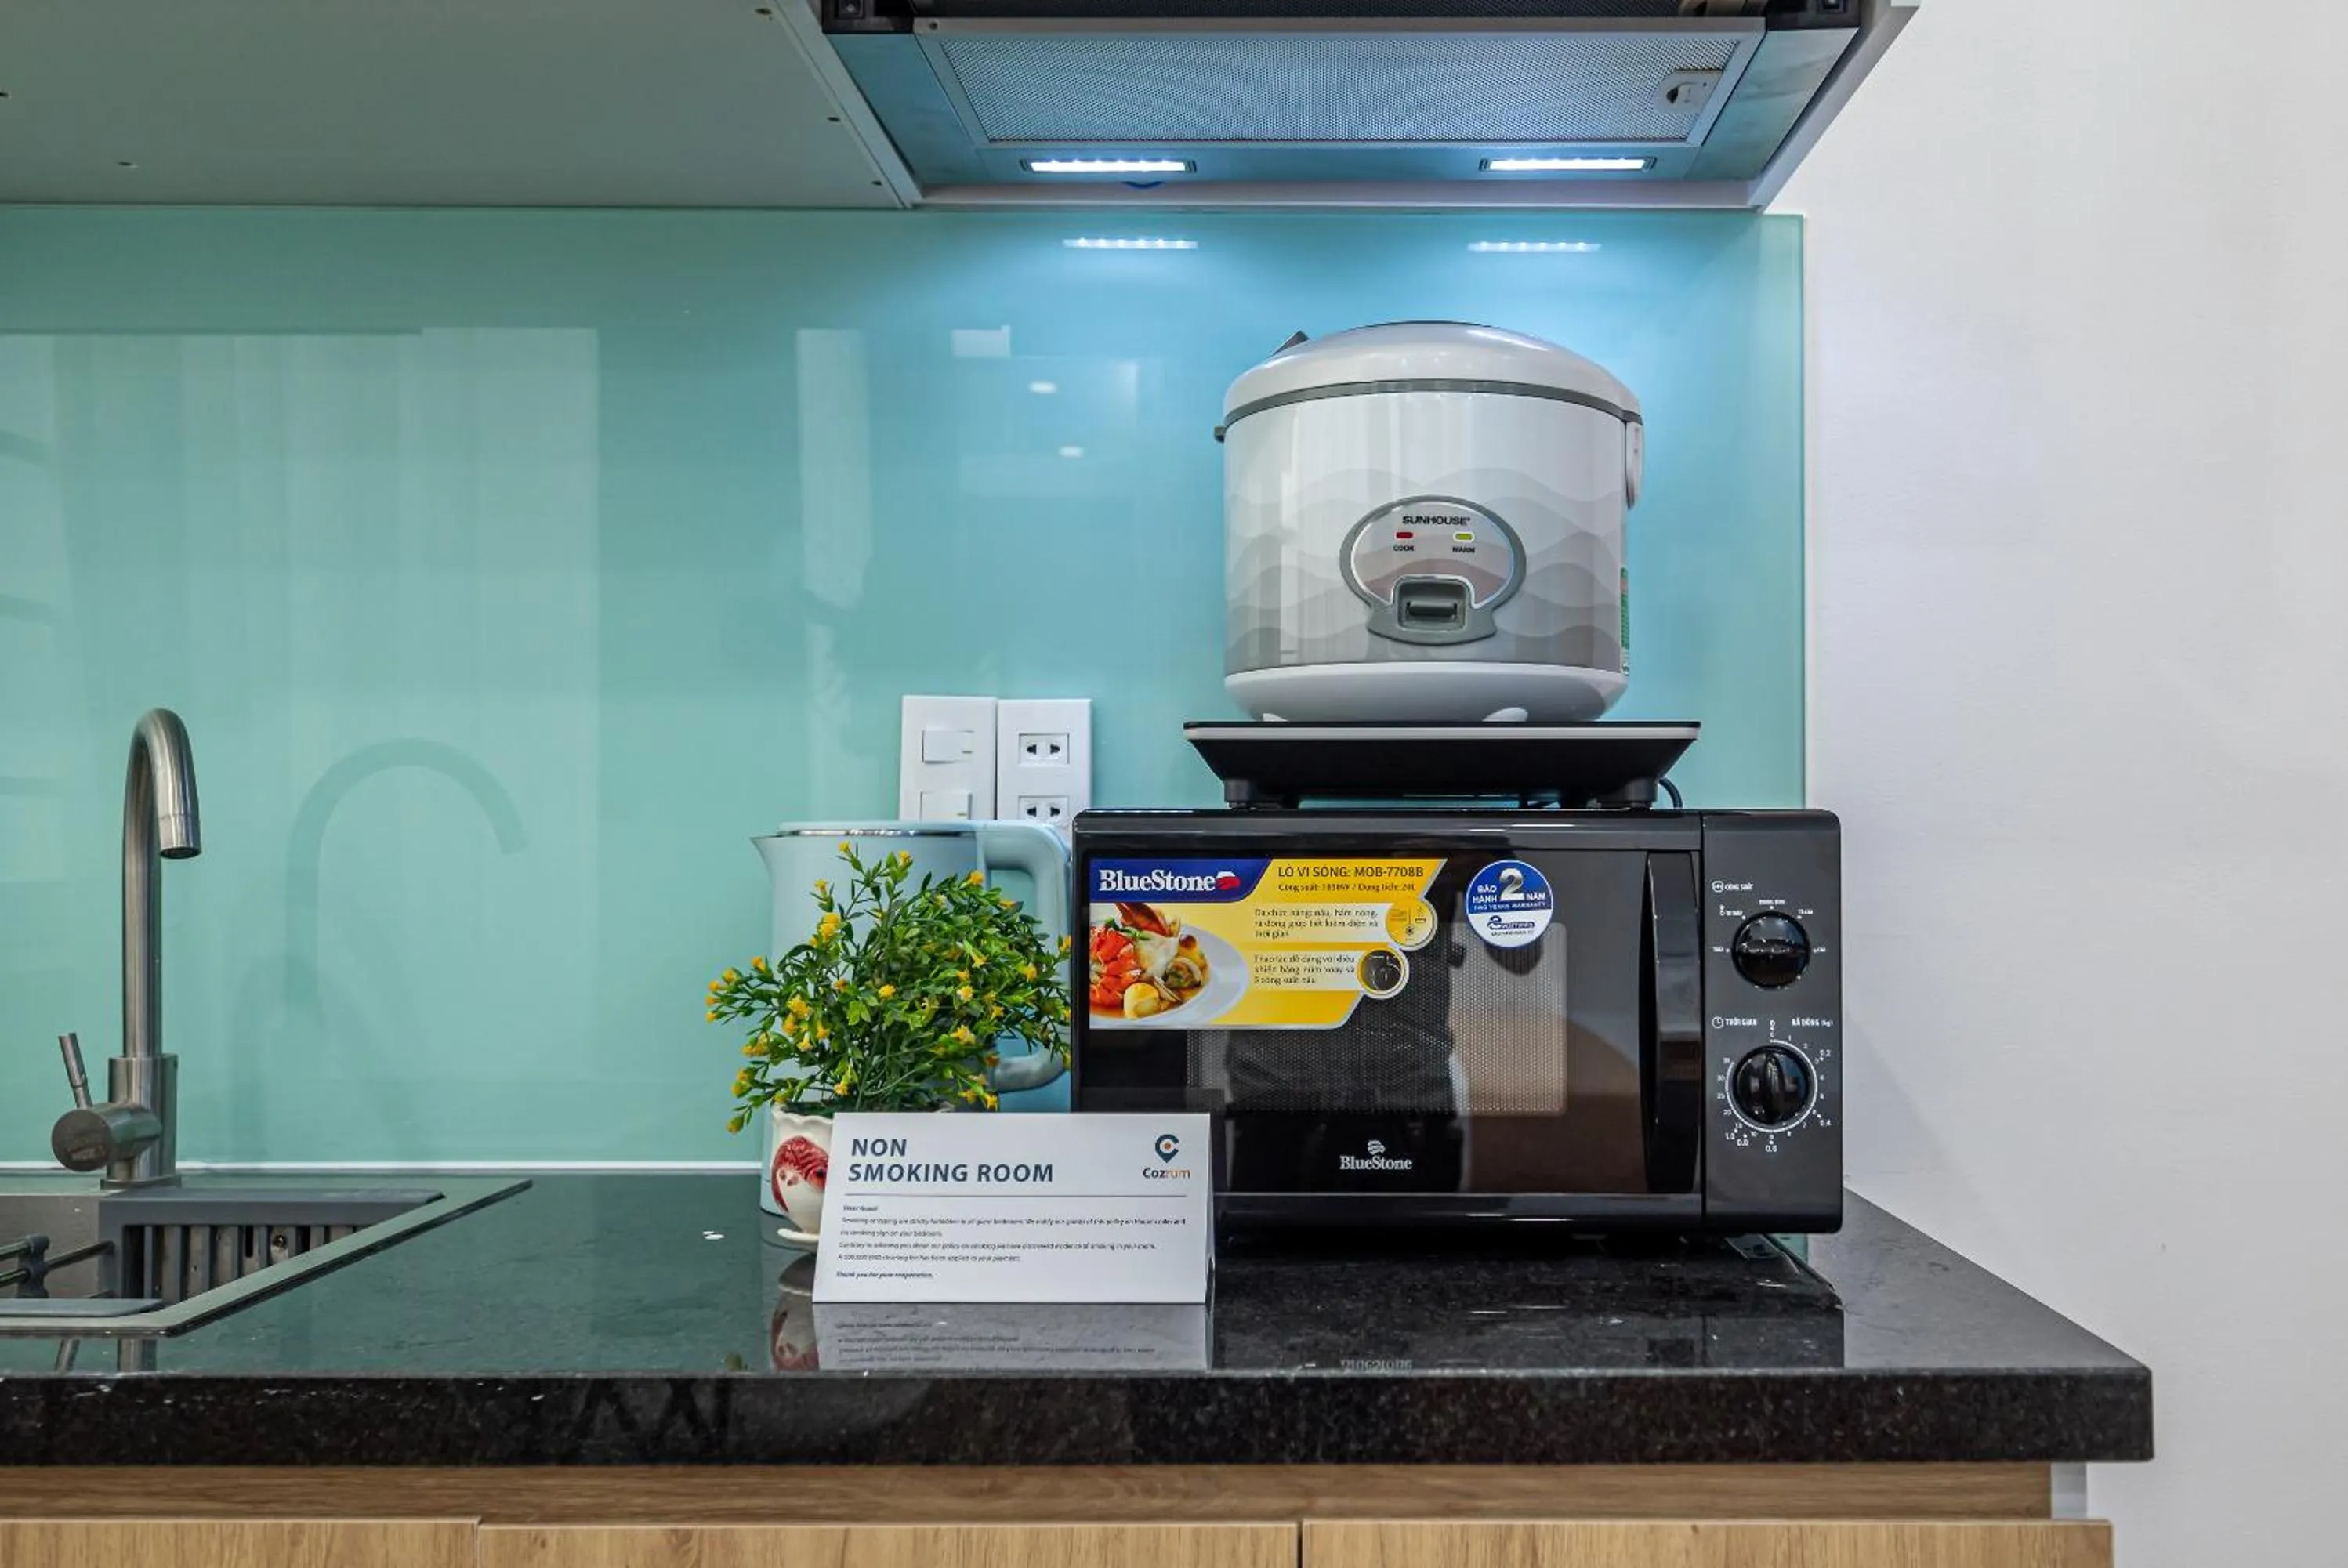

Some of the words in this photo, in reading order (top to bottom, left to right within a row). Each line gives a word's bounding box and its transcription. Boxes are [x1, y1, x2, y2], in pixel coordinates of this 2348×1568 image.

[1402, 516, 1468, 526] SUNHOUSE
[1098, 869, 1216, 892] BlueStone
[1297, 867, 1310, 877] VI
[1353, 867, 1424, 878] MOB-7708B
[1499, 867, 1525, 901] 2
[850, 1138, 908, 1157] NON
[1339, 1155, 1412, 1170] BlueStone
[847, 1163, 969, 1182] SMOKING
[977, 1164, 1053, 1182] ROOM
[1142, 1167, 1191, 1179] Cozrum
